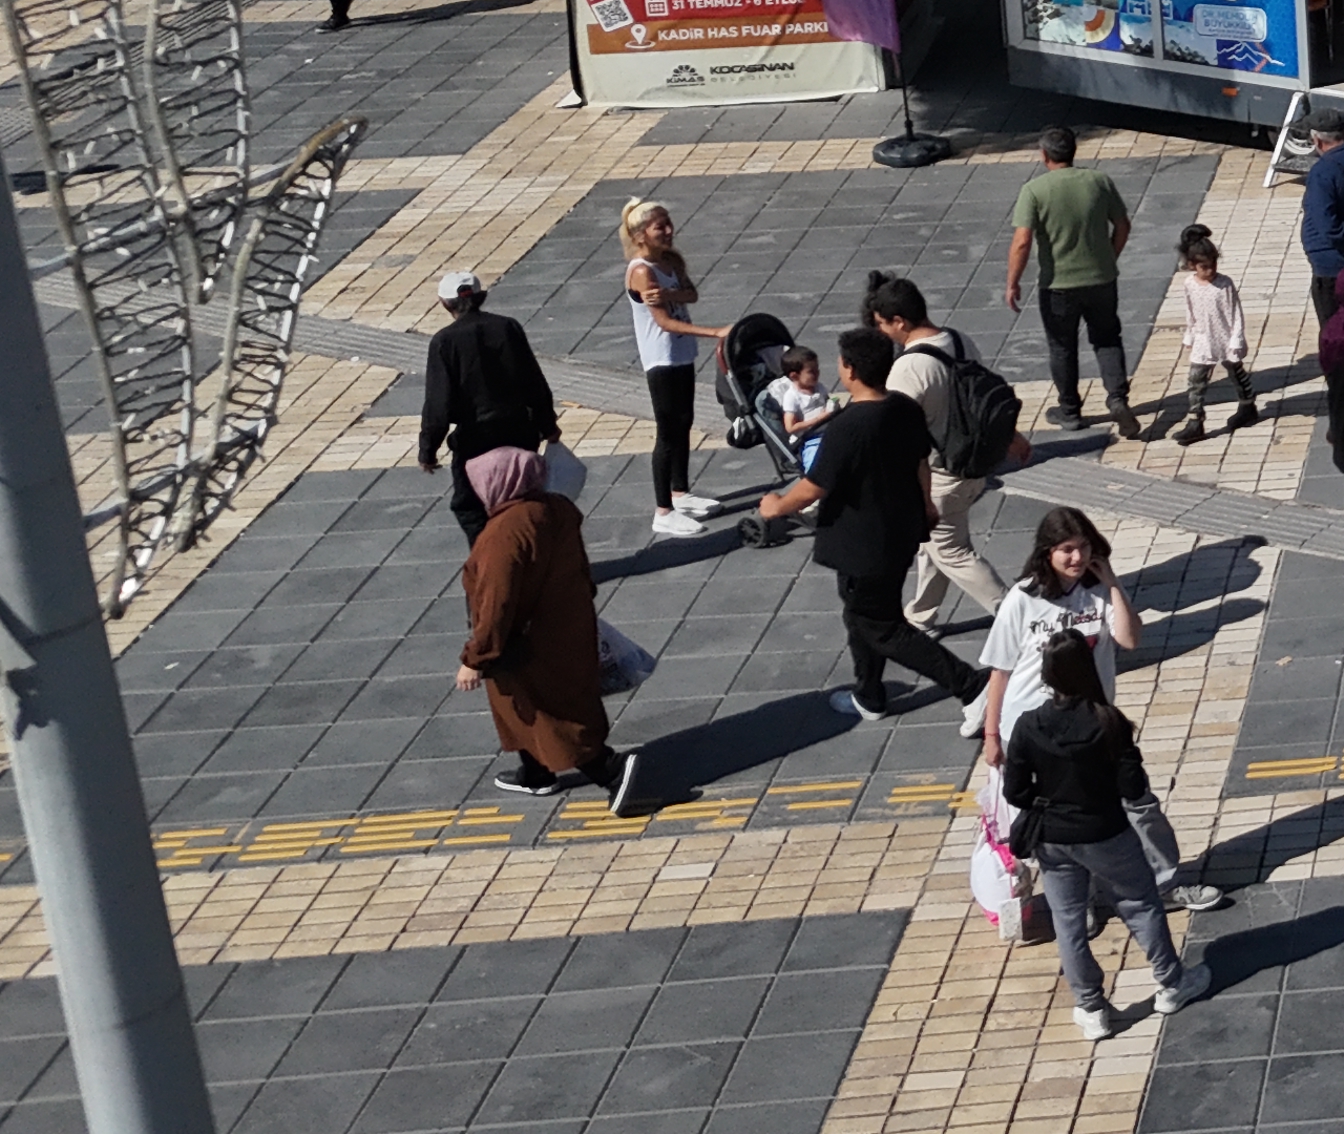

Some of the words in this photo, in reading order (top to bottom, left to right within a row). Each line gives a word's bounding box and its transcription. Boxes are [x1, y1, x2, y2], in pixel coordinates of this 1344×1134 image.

[672, 0, 684, 10] 31
[707, 27, 738, 39] HAS
[741, 24, 781, 38] FUAR
